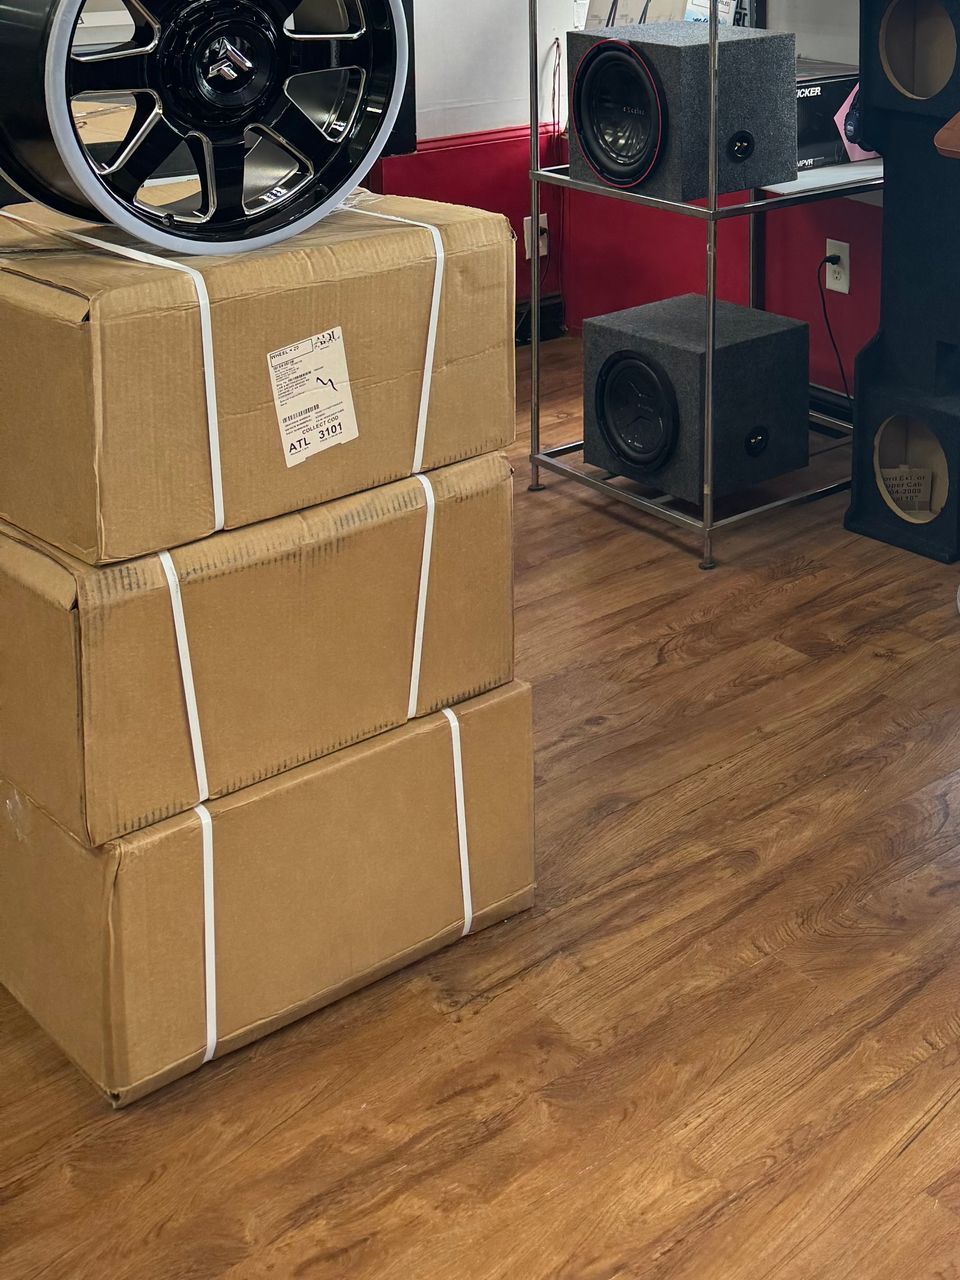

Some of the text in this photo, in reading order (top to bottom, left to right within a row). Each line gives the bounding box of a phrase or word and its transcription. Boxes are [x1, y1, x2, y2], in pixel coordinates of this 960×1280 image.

[796, 87, 821, 98] ICKER
[302, 420, 326, 435] COLLECT
[289, 437, 311, 453] ATL
[318, 422, 343, 439] 3101
